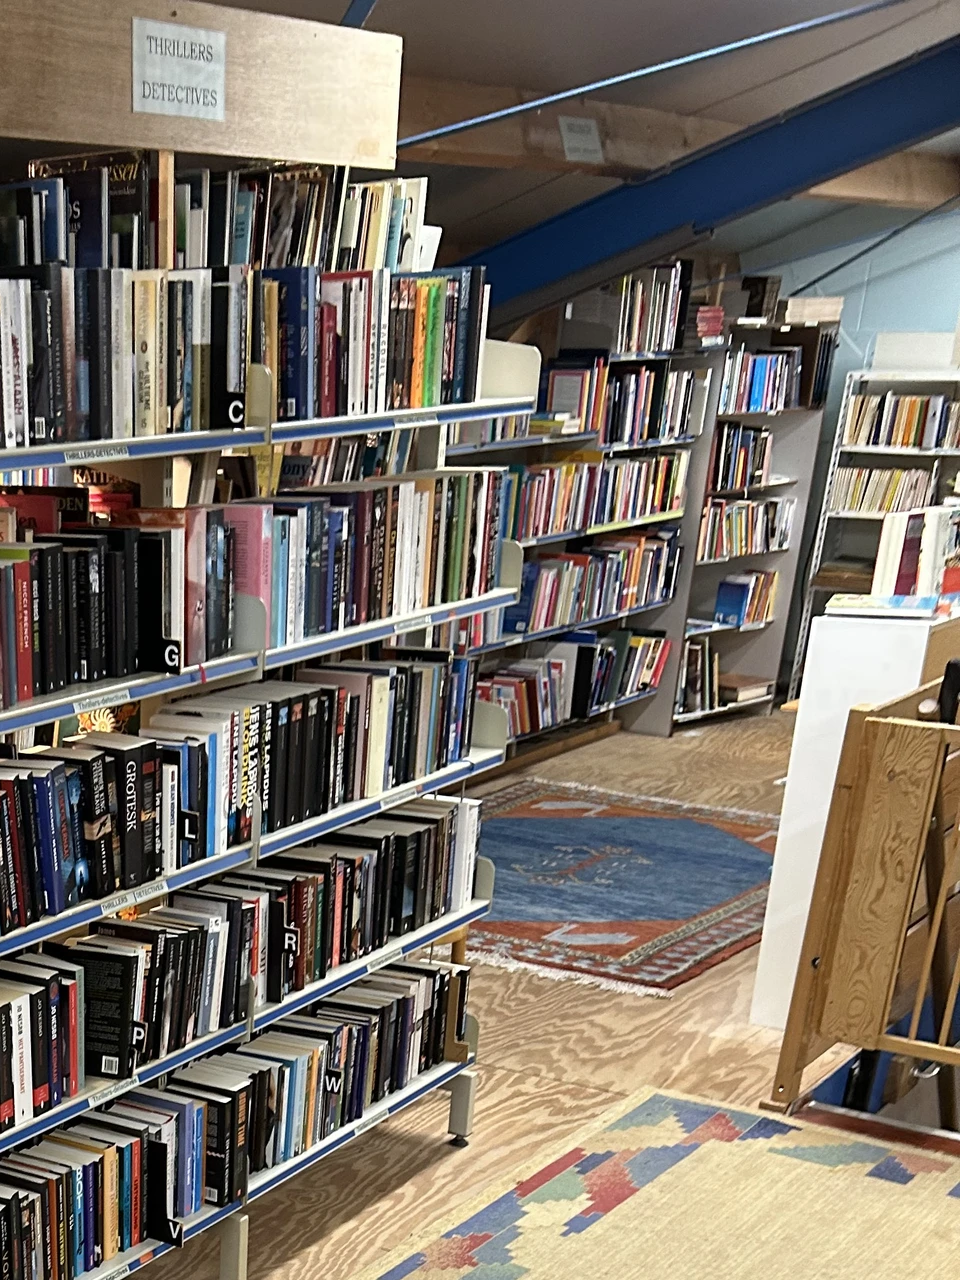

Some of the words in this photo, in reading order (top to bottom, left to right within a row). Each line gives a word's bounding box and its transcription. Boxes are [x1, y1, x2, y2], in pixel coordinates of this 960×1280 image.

[145, 35, 214, 63] THRILLERS
[141, 80, 218, 108] DETECTIVES
[228, 401, 244, 423] C
[165, 645, 179, 666] G
[126, 761, 137, 831] GROTESK
[185, 818, 196, 839] L
[285, 933, 296, 950] R
[133, 1027, 144, 1044] P
[325, 1076, 341, 1094] W
[168, 1220, 182, 1239] V
